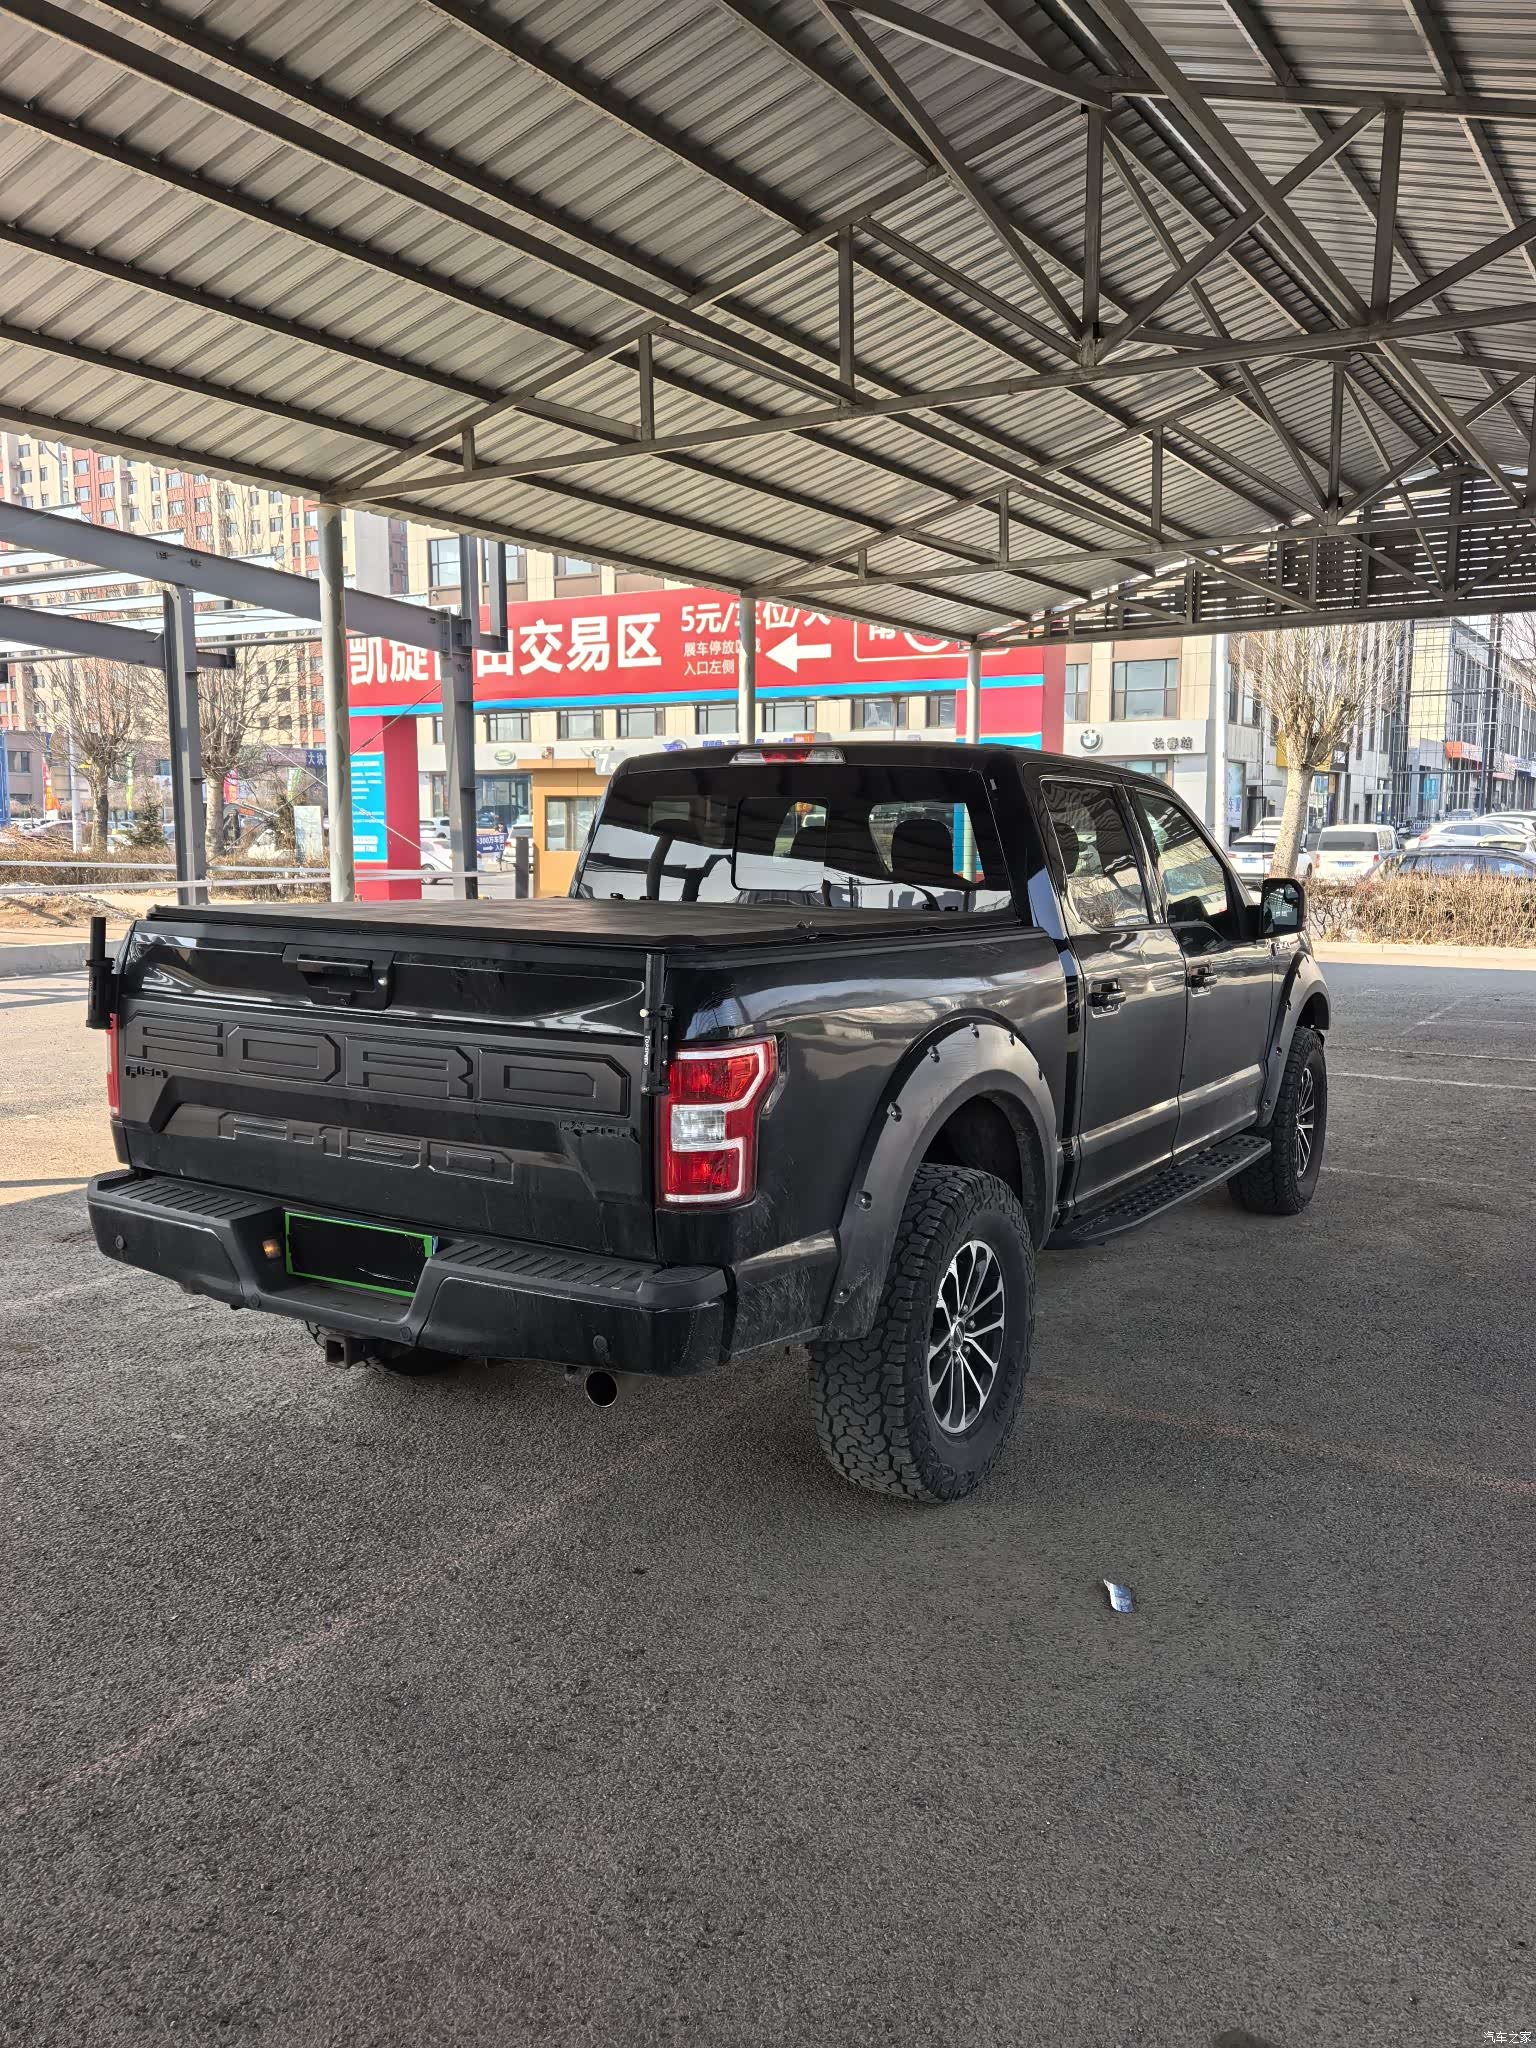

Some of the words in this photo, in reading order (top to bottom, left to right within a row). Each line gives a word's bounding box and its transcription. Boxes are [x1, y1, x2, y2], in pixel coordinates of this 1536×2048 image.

[684, 660, 735, 676] 入口左侧
[125, 1010, 631, 1118] FORD
[218, 1111, 513, 1184] F-150
